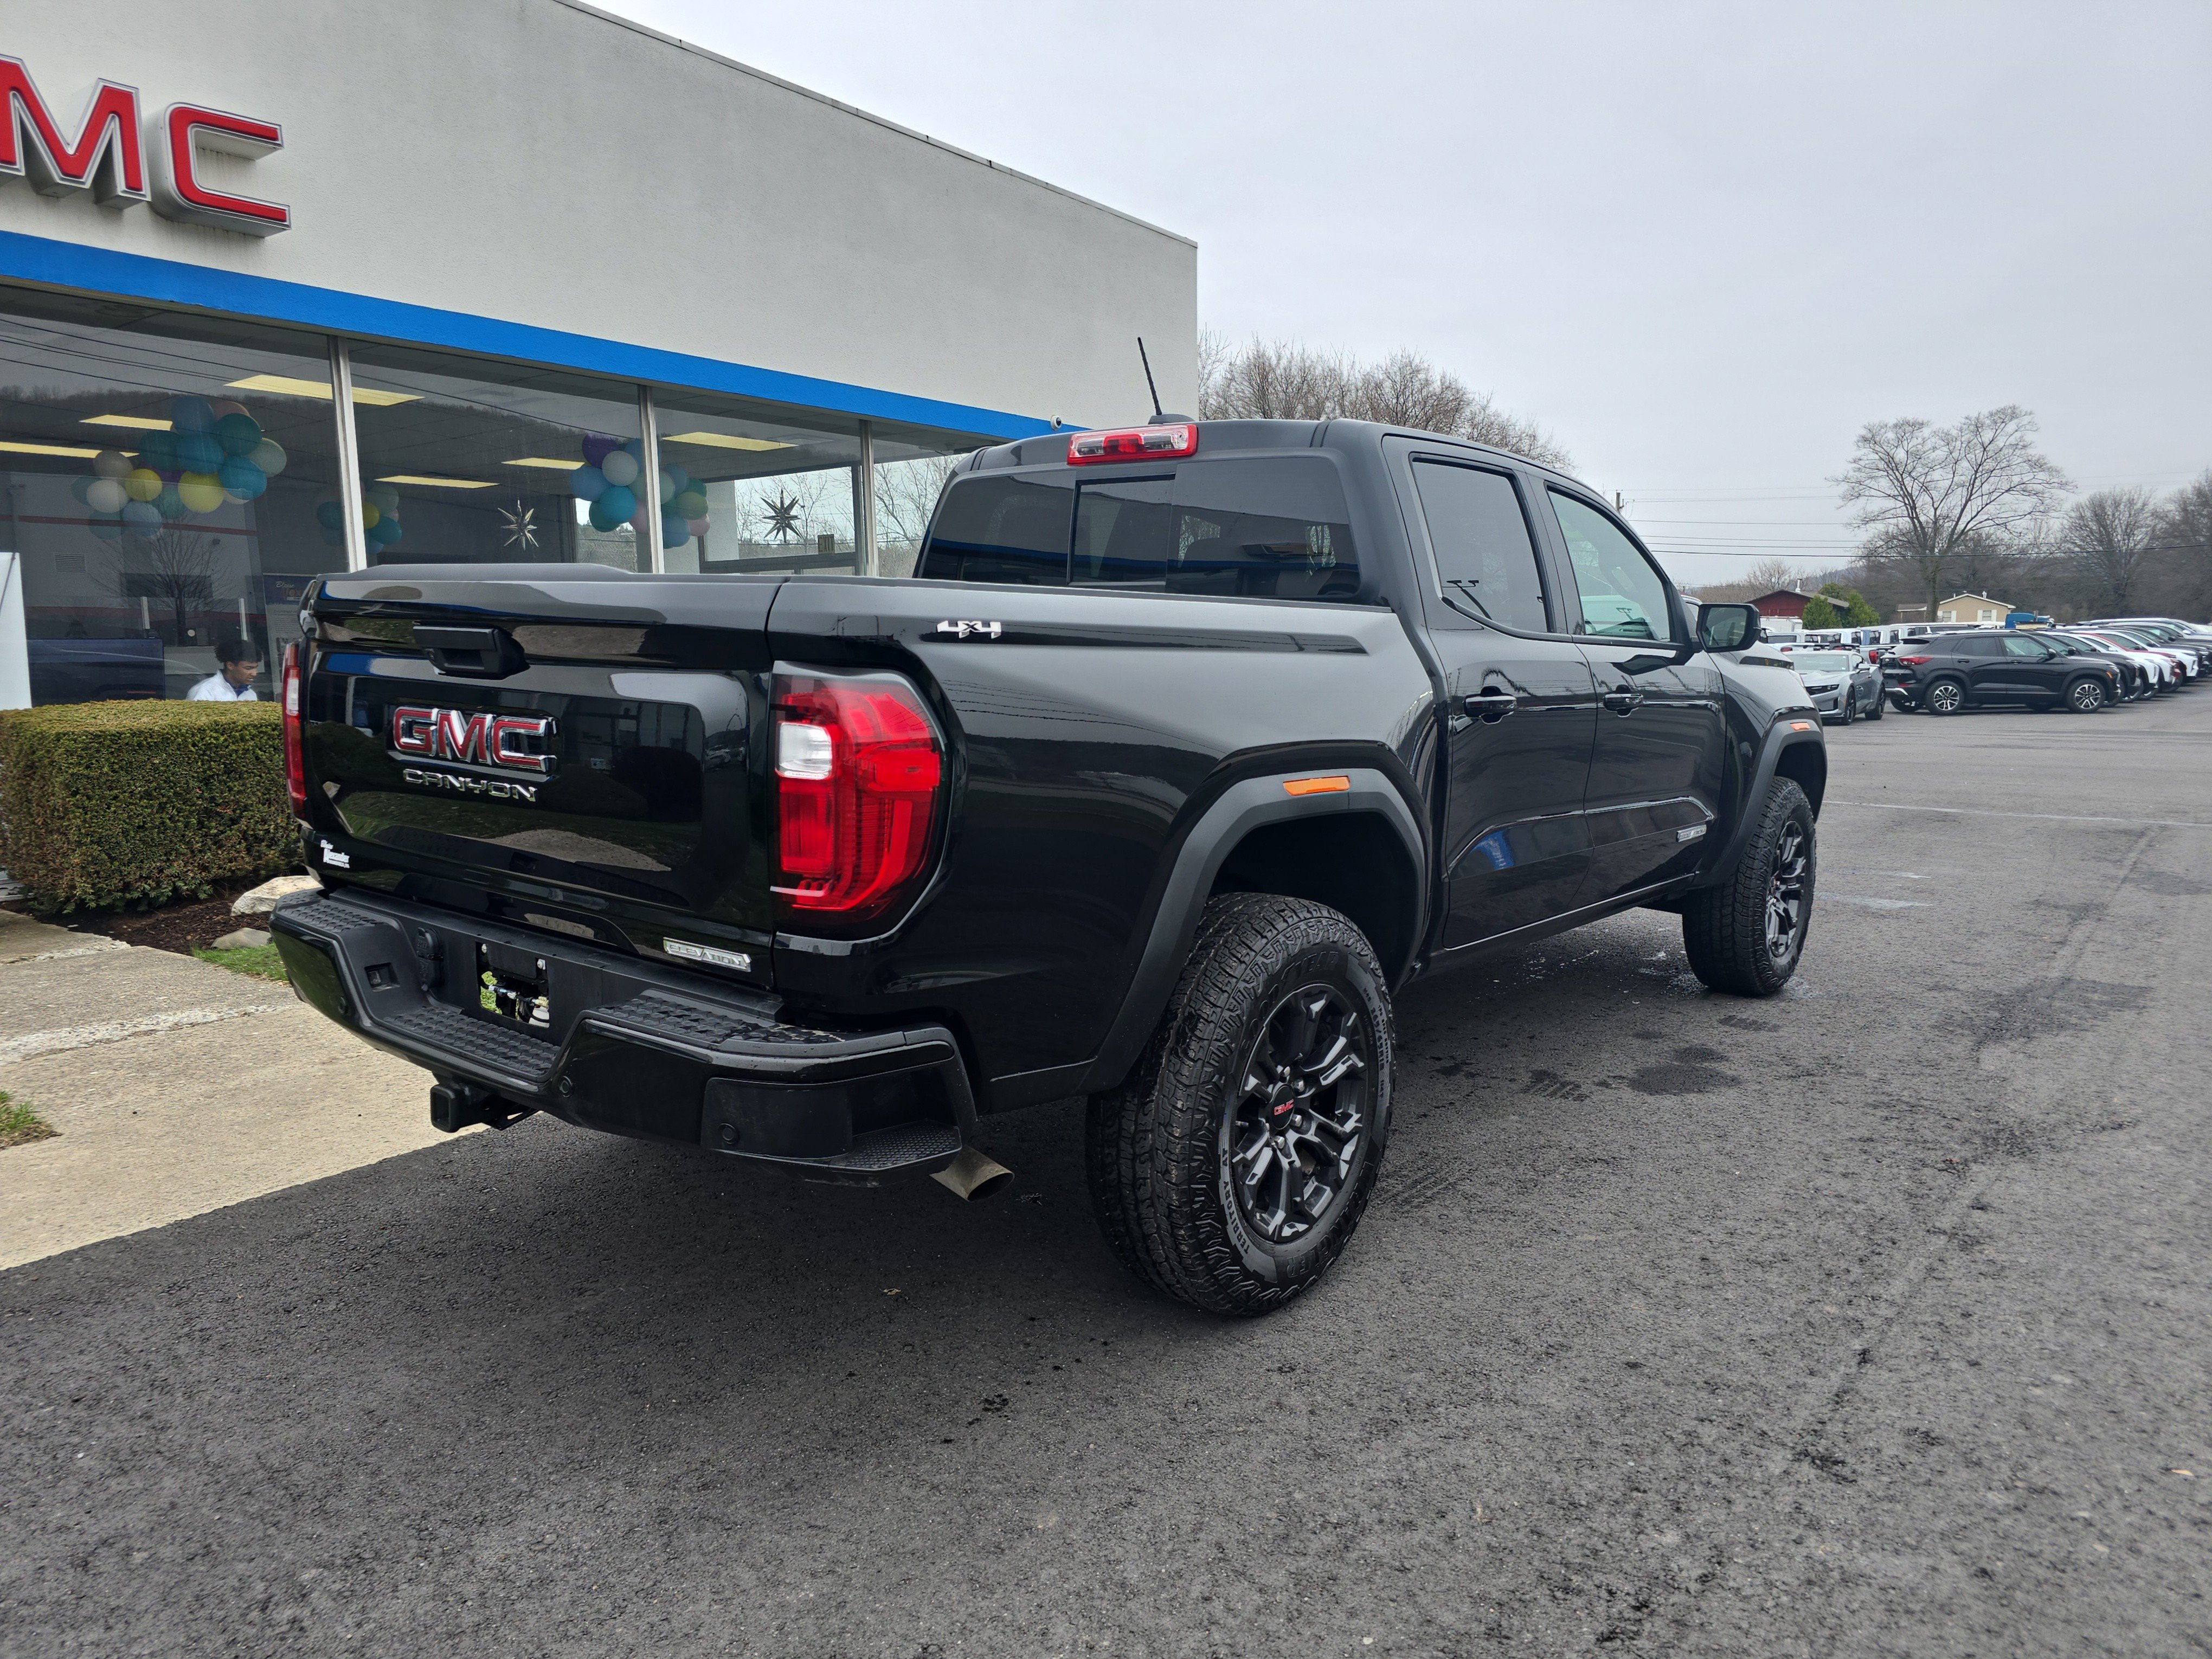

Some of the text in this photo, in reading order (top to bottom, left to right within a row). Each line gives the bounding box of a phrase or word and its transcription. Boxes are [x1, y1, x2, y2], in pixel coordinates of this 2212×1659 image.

[394, 706, 557, 773] GMC
[402, 768, 538, 802] CANYON
[669, 943, 743, 966] ELEVATION
[1274, 1098, 1295, 1116] GMC
[1223, 1180, 1249, 1254] TERRITORY
